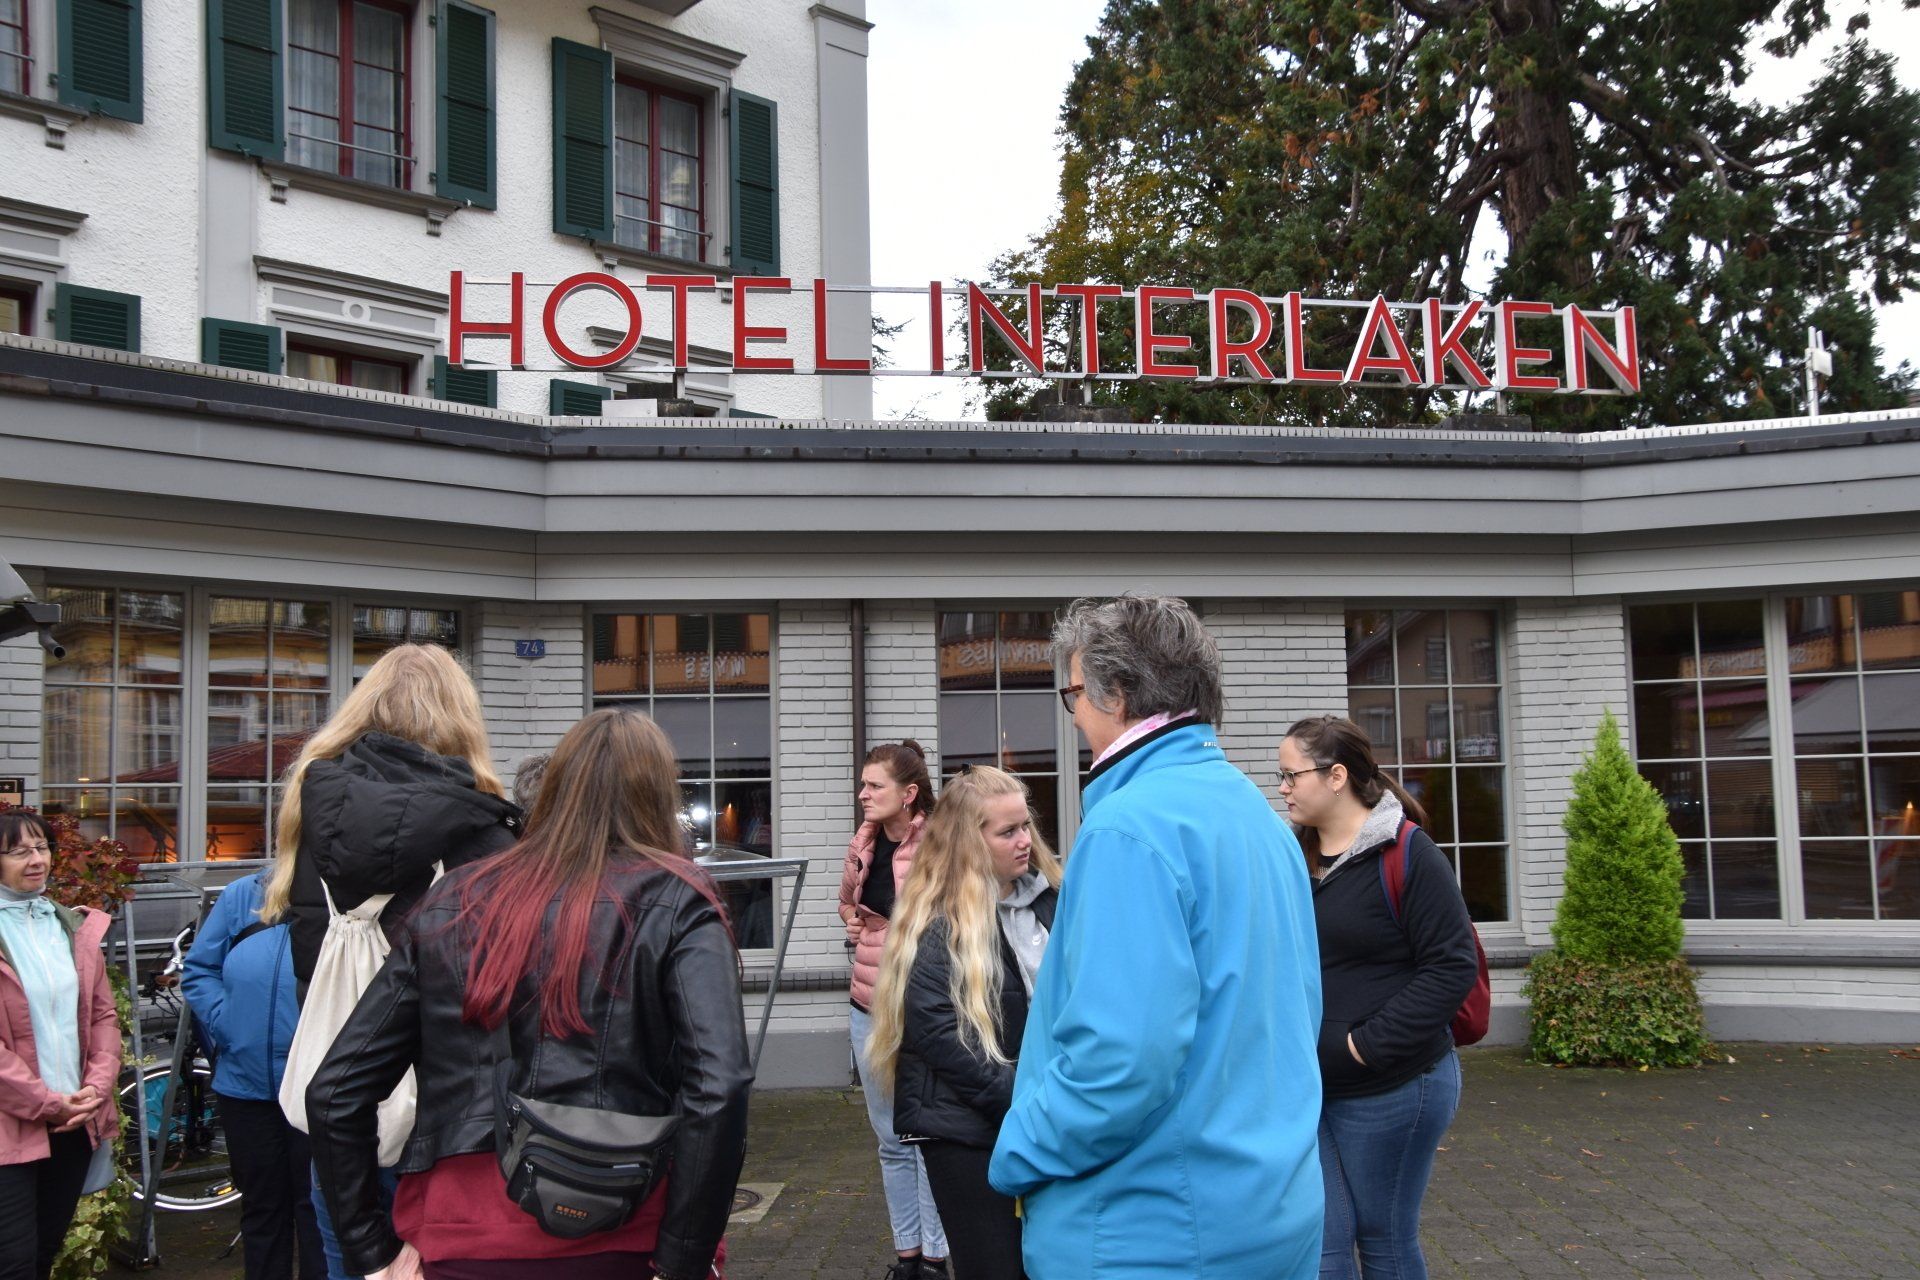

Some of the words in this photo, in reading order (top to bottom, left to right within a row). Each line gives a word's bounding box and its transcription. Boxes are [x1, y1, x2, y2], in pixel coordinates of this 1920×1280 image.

[448, 270, 872, 374] HOTEL
[928, 280, 1641, 396] INTERLAKEN
[521, 641, 538, 655] 74
